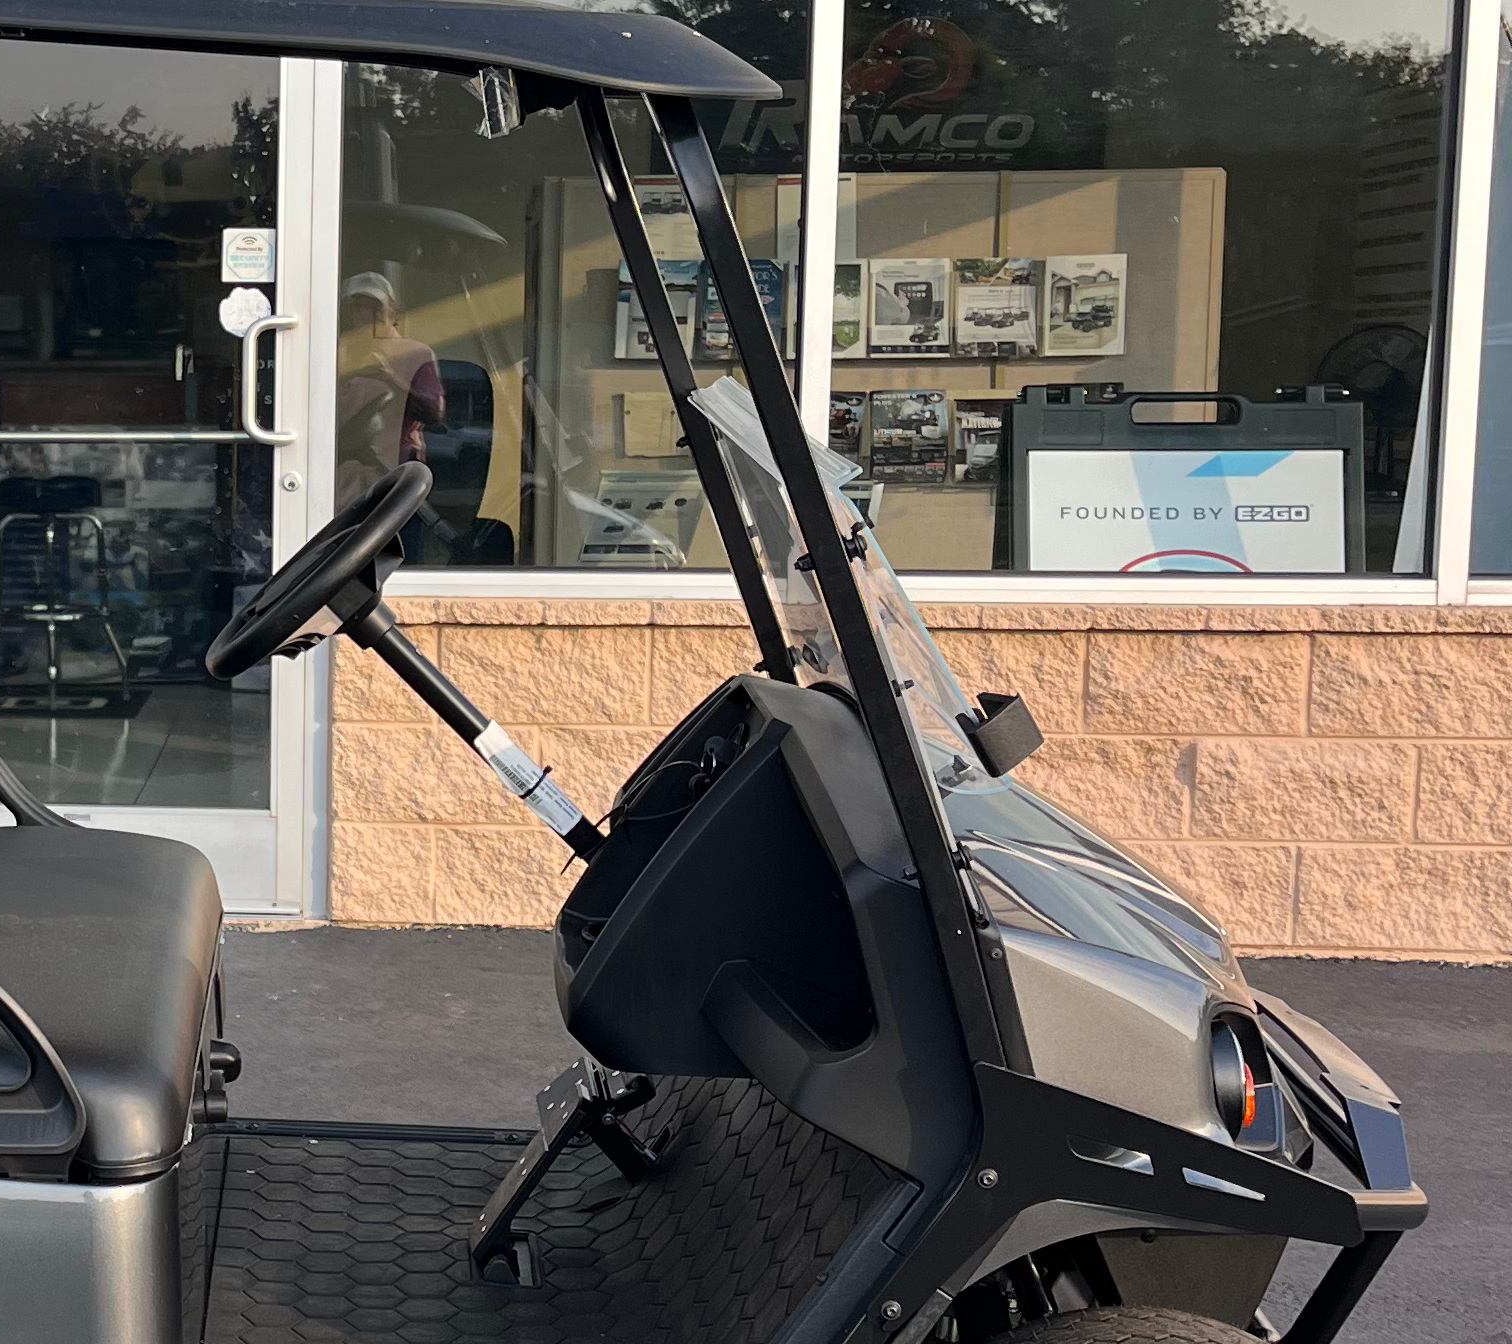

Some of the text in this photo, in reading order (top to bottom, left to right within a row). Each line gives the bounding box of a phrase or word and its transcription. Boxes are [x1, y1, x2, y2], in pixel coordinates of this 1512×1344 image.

[230, 254, 268, 262] SECURITY
[1060, 506, 1309, 522] FOUNDED BY EZGO
